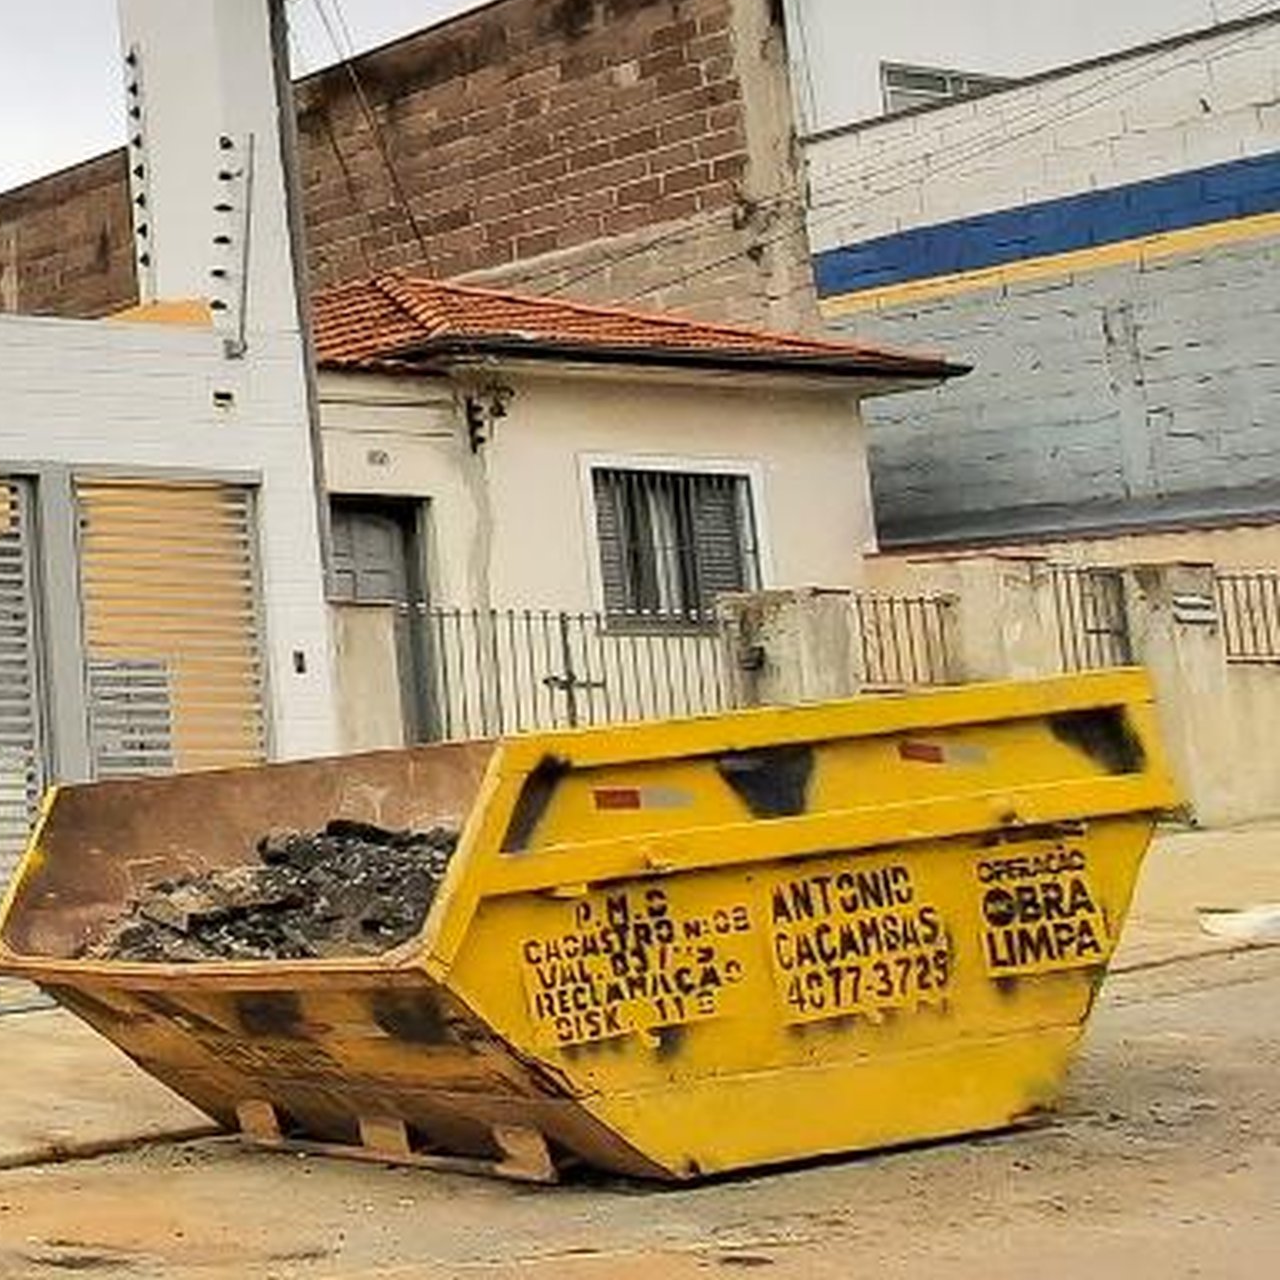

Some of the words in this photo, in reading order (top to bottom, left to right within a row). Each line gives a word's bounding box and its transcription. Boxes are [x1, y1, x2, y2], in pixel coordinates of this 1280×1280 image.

[772, 867, 912, 924] ANTONIO
[984, 879, 1095, 927] OBRA
[987, 920, 1101, 967] LIMPA
[788, 951, 949, 1011] 4077-3729
